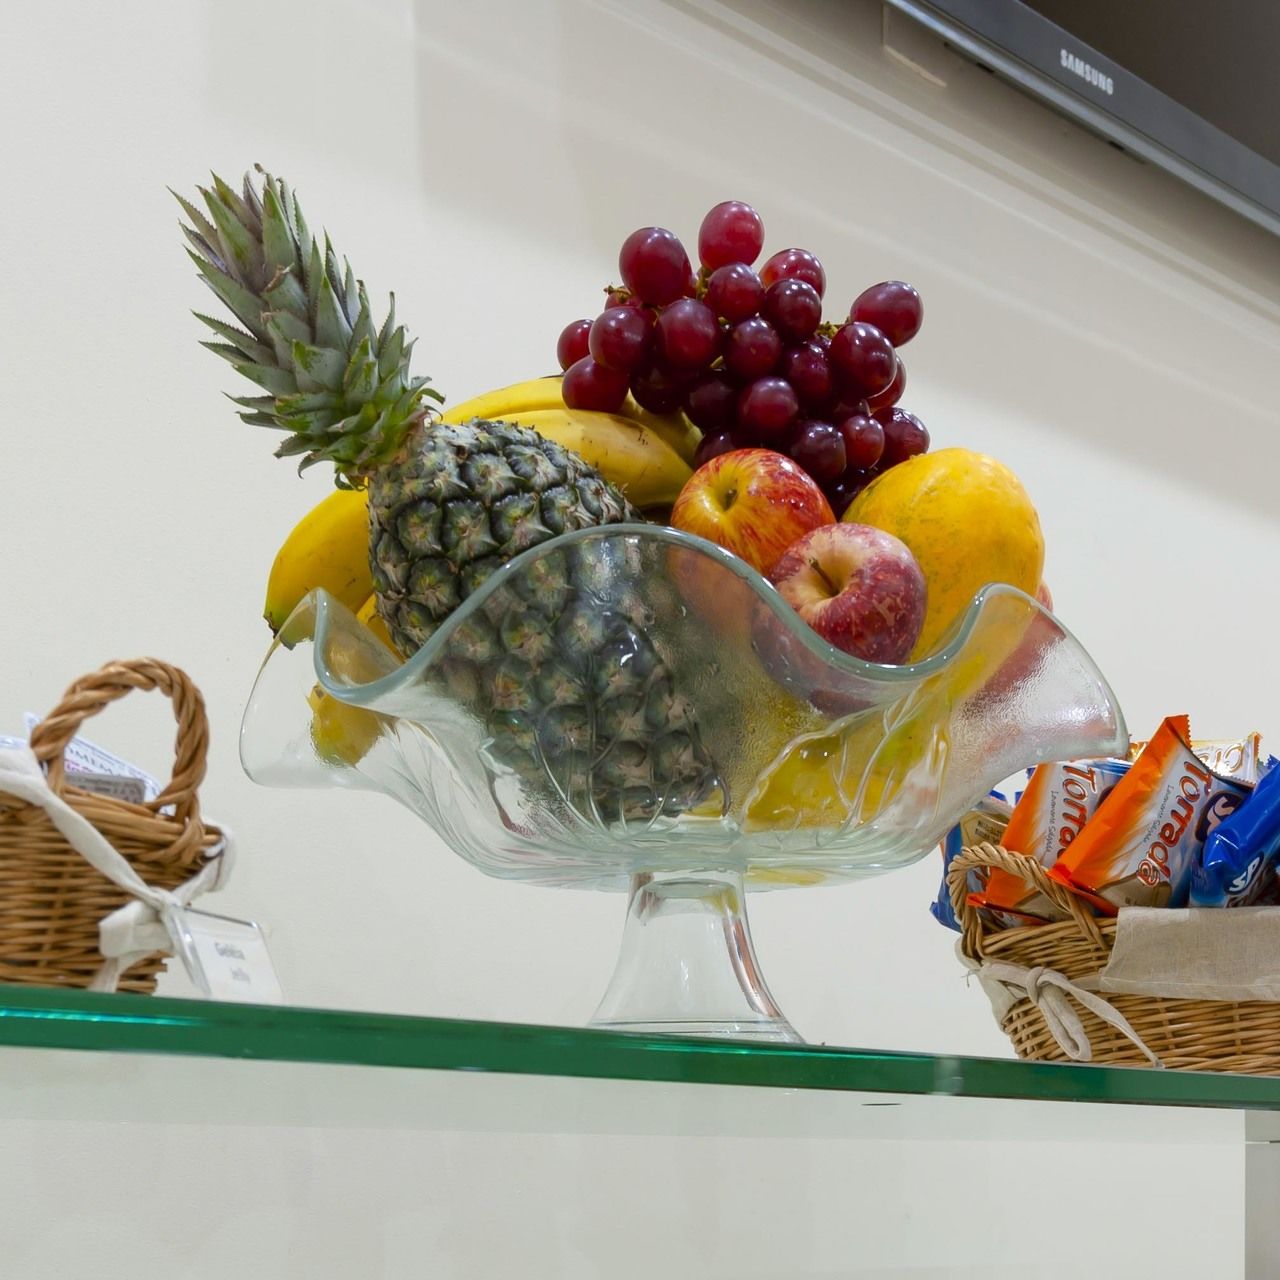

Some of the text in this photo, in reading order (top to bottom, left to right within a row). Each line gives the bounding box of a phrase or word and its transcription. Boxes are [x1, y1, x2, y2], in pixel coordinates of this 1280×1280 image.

[1060, 48, 1114, 96] SAMSUNG
[1136, 760, 1214, 888] Torrada
[1229, 856, 1260, 892] SP
